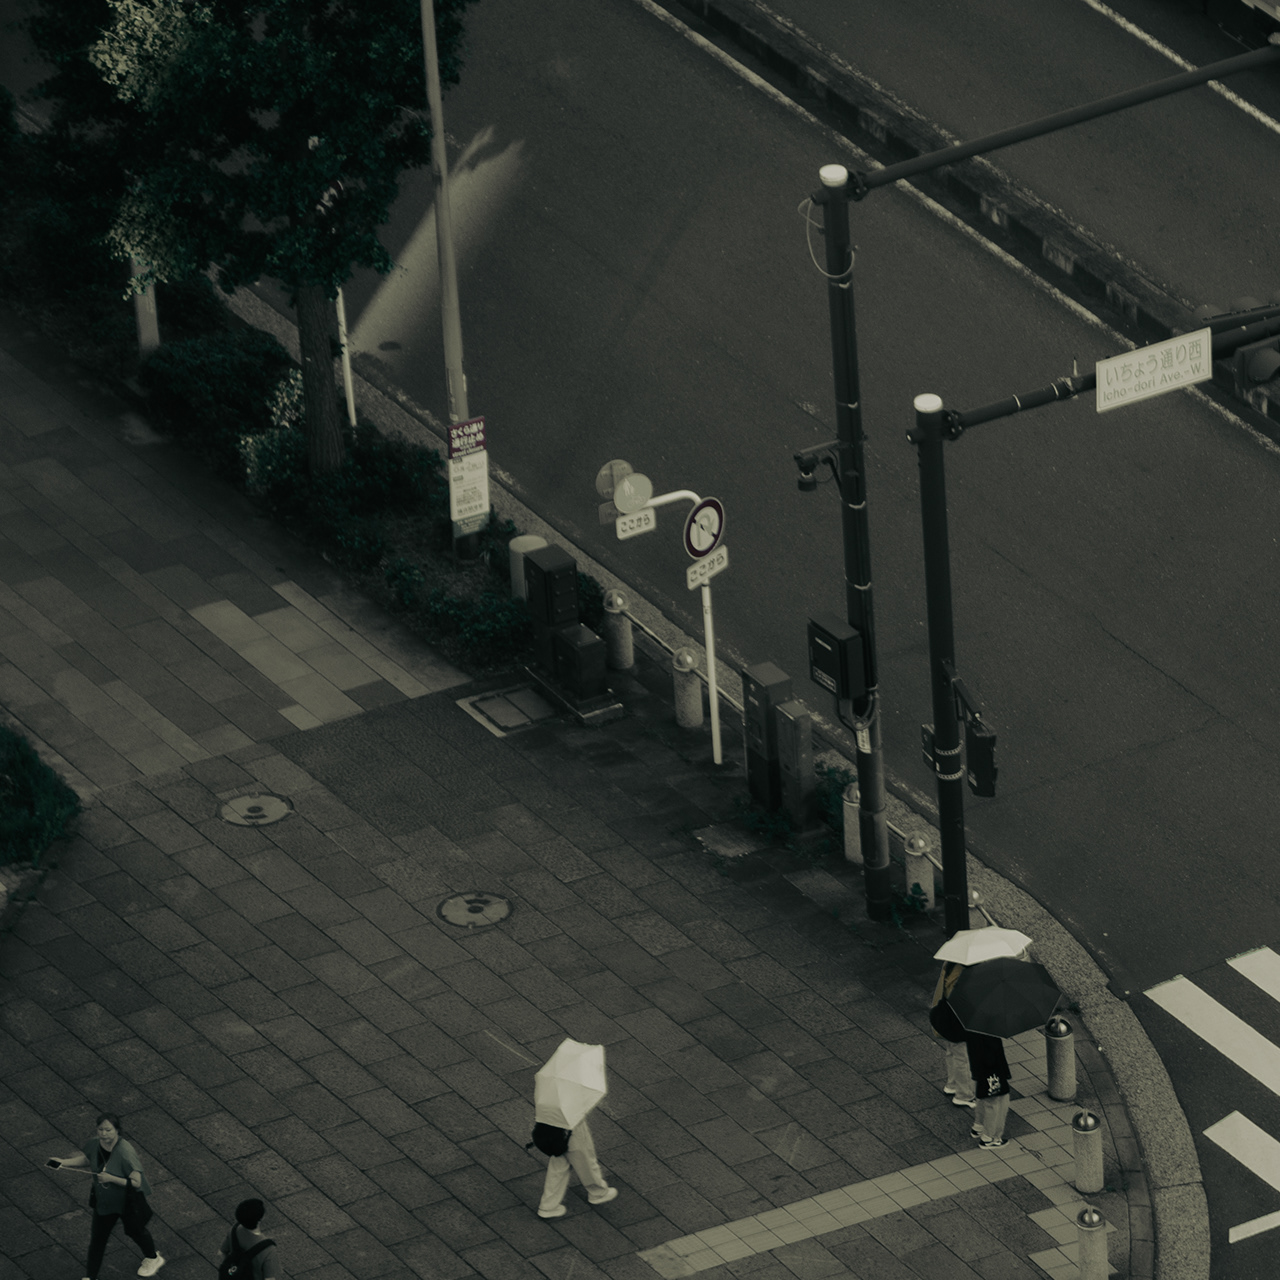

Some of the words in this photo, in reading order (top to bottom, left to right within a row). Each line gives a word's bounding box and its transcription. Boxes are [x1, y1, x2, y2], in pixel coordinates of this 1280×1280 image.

[1105, 339, 1202, 386] いちょう通り西
[1103, 376, 1155, 402] Icho-dori
[1160, 362, 1205, 384] Ave.-W.
[620, 514, 651, 533] ここから
[690, 553, 724, 583] ここから
